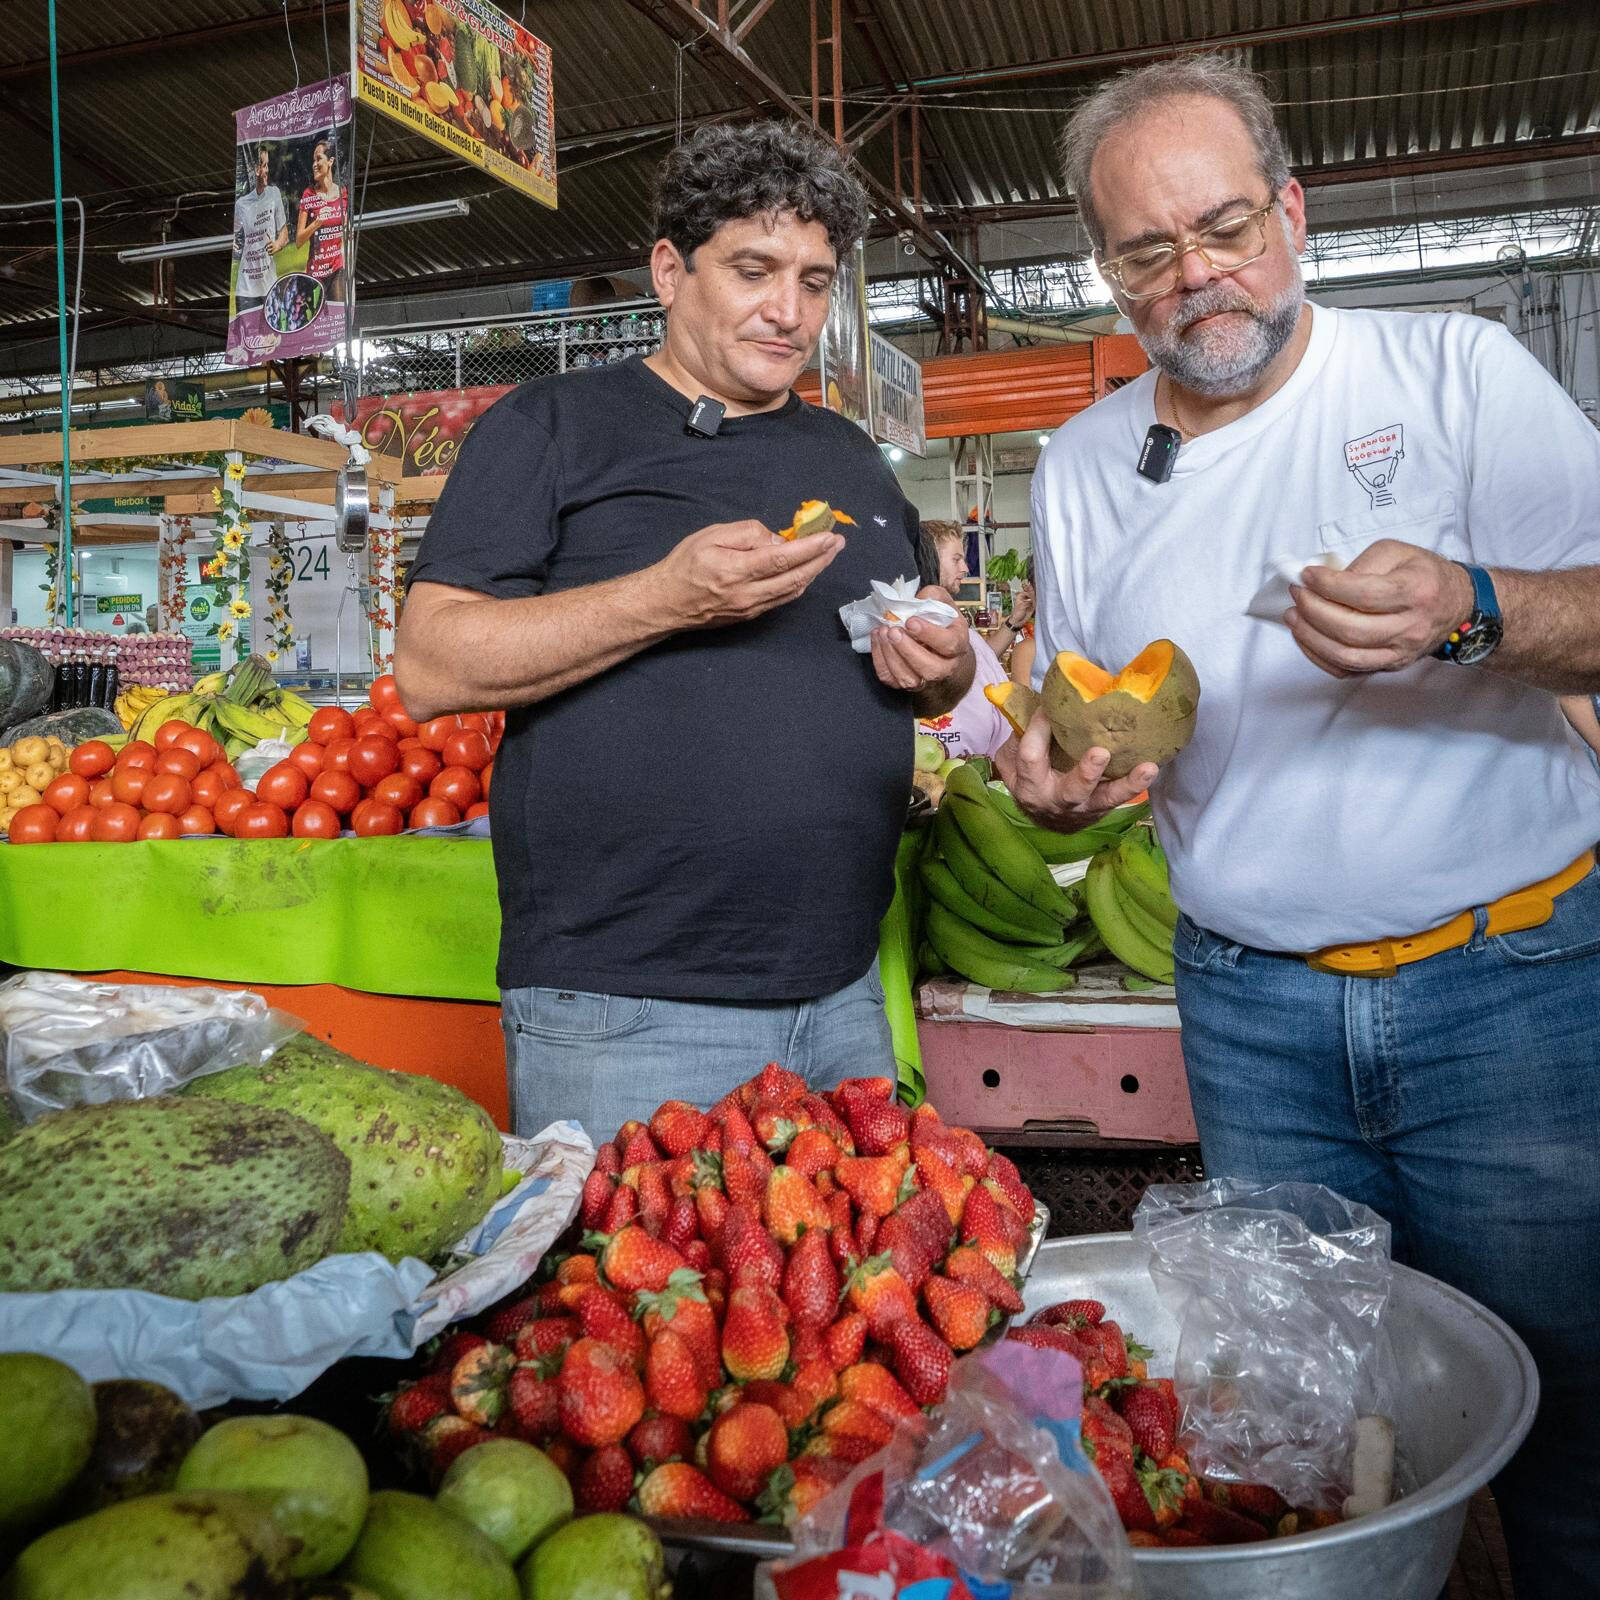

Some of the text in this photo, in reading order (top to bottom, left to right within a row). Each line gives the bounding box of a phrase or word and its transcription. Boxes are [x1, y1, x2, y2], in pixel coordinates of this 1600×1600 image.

[483, 8, 516, 40] EXOTICAS
[457, 7, 467, 23] &
[468, 13, 514, 55] GLORIA
[362, 77, 386, 104] Puesto
[386, 93, 400, 112] 599
[400, 97, 424, 125] Interior
[446, 125, 473, 153] Alameda
[318, 263, 331, 271] ANTI
[171, 399, 197, 412] Vidas
[114, 496, 145, 507] Hierbas
[111, 595, 140, 605] PEDIDOS
